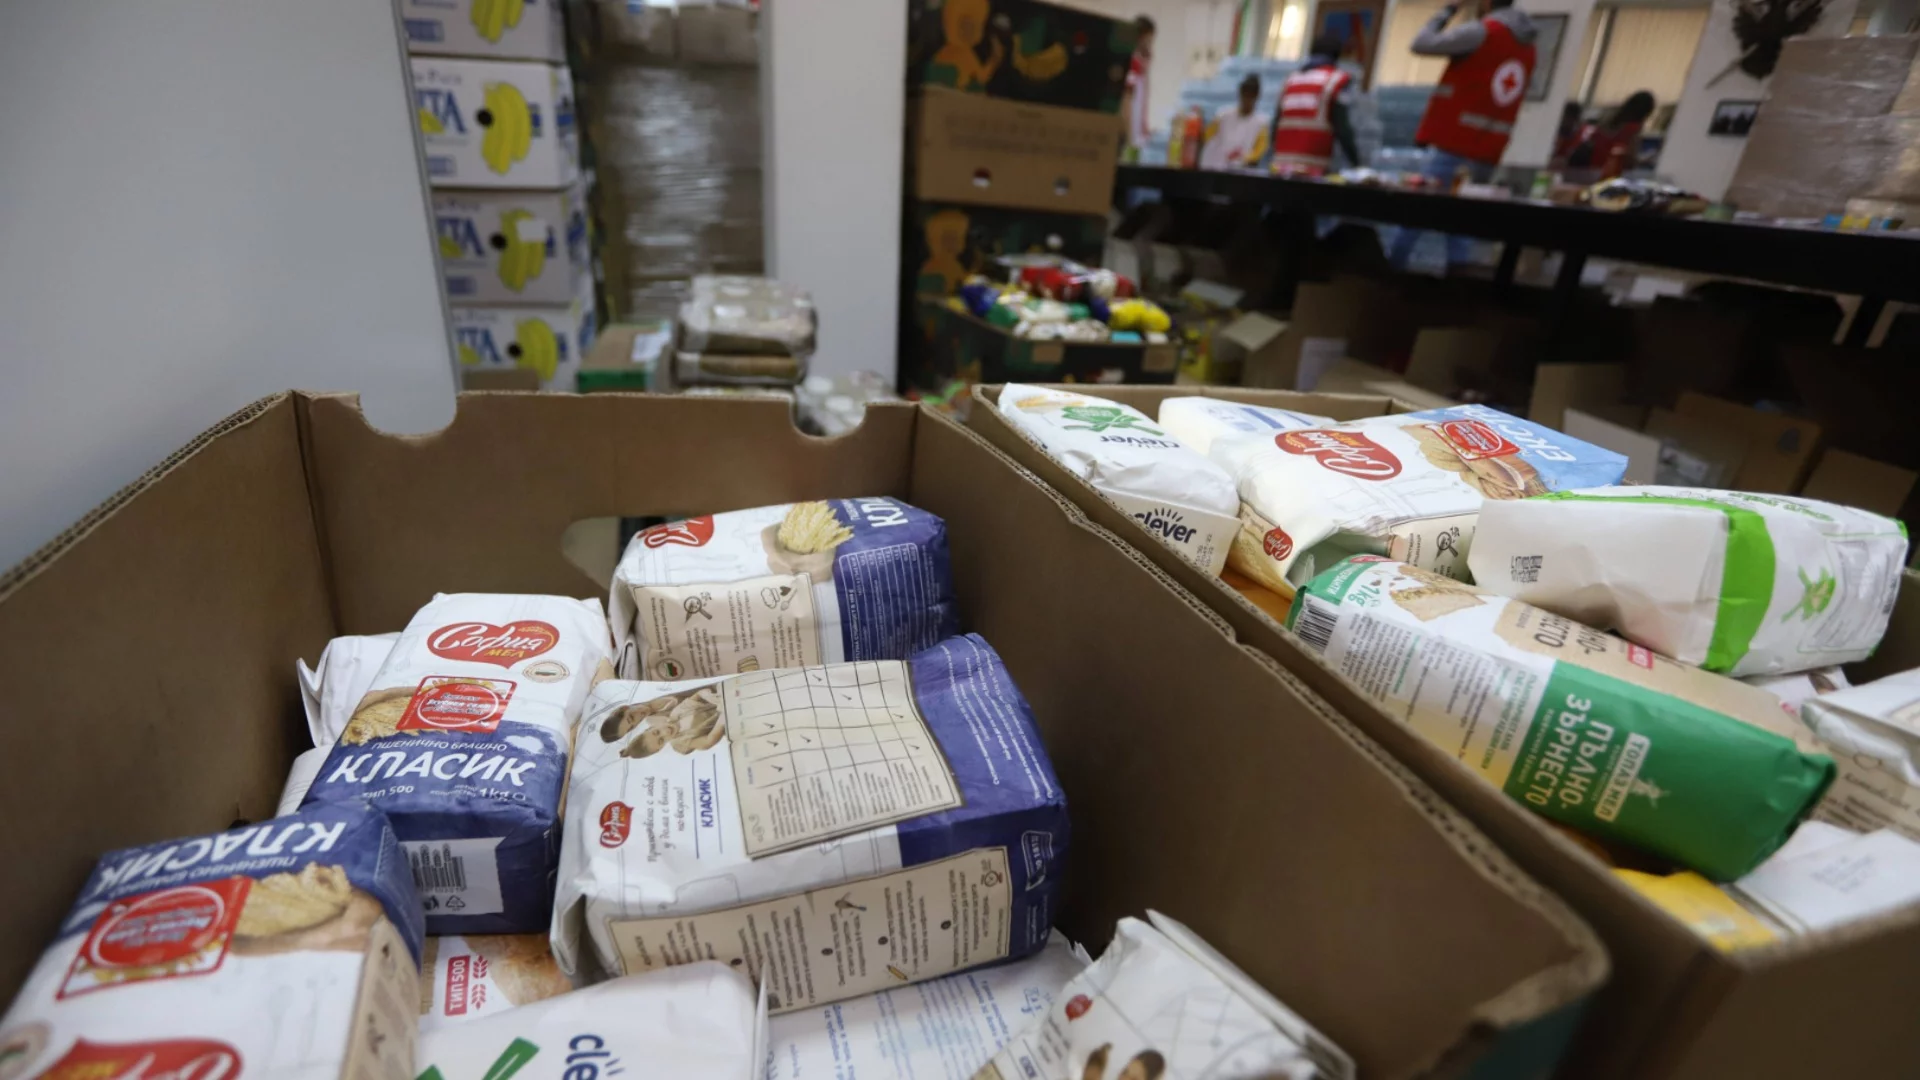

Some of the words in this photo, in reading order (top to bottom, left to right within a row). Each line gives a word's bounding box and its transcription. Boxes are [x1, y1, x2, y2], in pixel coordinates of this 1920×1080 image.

[1100, 435, 1180, 449] clever
[1302, 431, 1395, 476] София
[433, 624, 546, 656] София
[484, 649, 525, 658] МЕЛ
[372, 738, 449, 749] ПШЕНИЧНО
[451, 742, 507, 751] БРАШНО
[1524, 693, 1591, 806] ЗЪРНЕСТО
[326, 751, 538, 787] КЛАСИК
[1559, 720, 1615, 809] ПЪЛНО-
[389, 785, 415, 795] 500
[699, 778, 714, 828] КЛАСИК
[95, 822, 347, 895] КЛАСИК
[452, 959, 466, 984] 500
[450, 984, 463, 1011] ТИП
